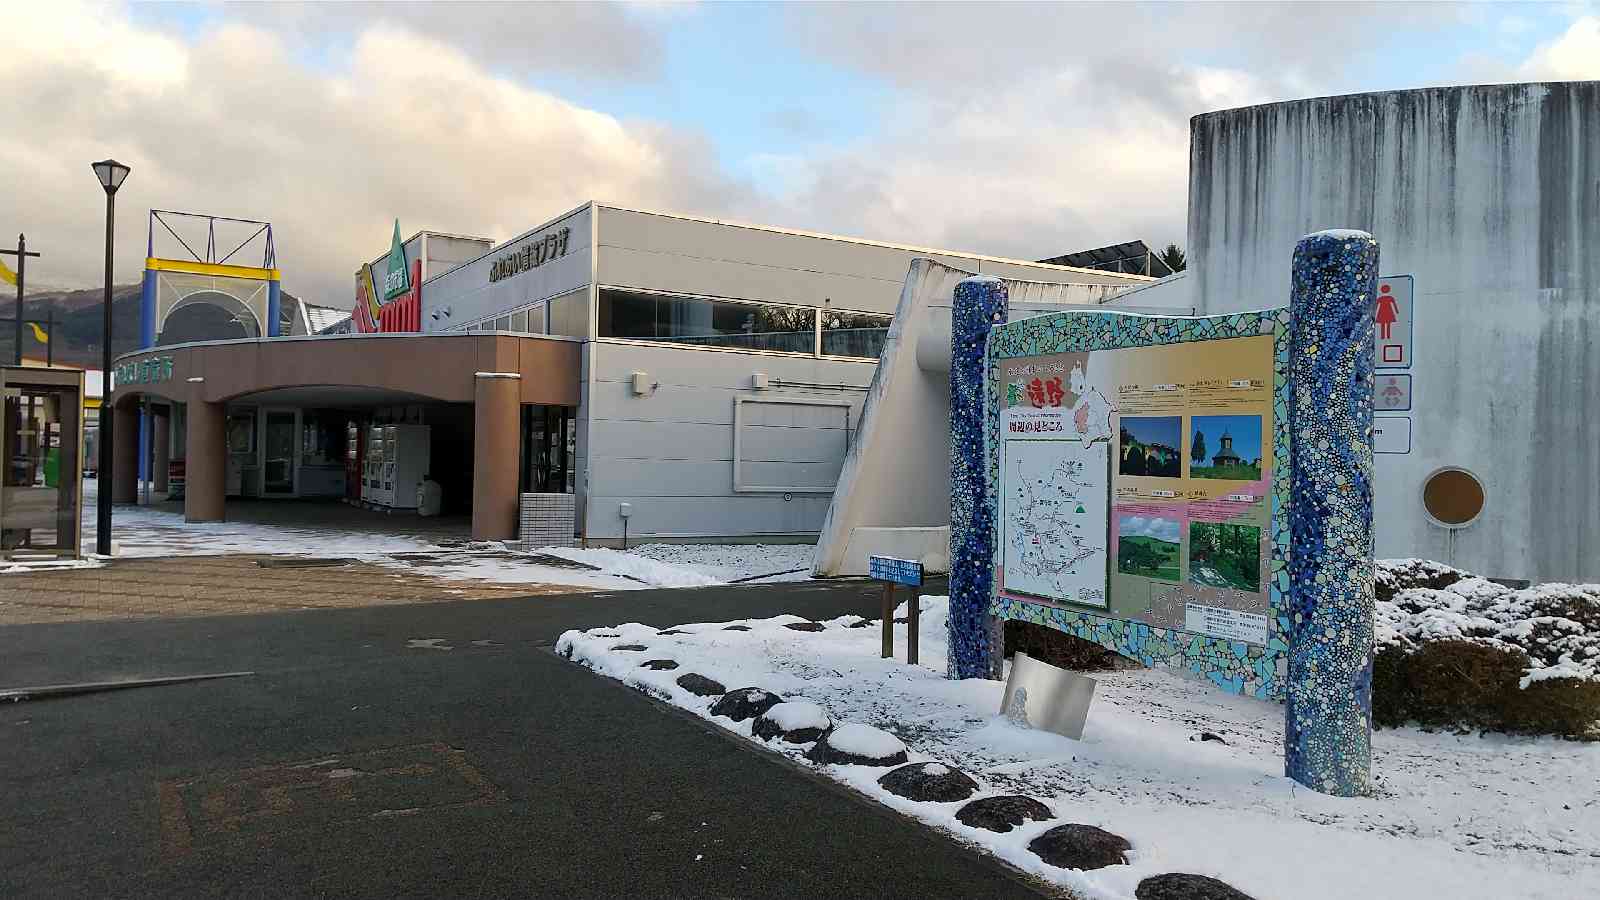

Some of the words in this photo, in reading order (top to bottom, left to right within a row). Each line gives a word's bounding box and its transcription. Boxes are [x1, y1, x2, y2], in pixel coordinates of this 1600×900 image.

[1008, 421, 1063, 433] 周辺の見どころ
